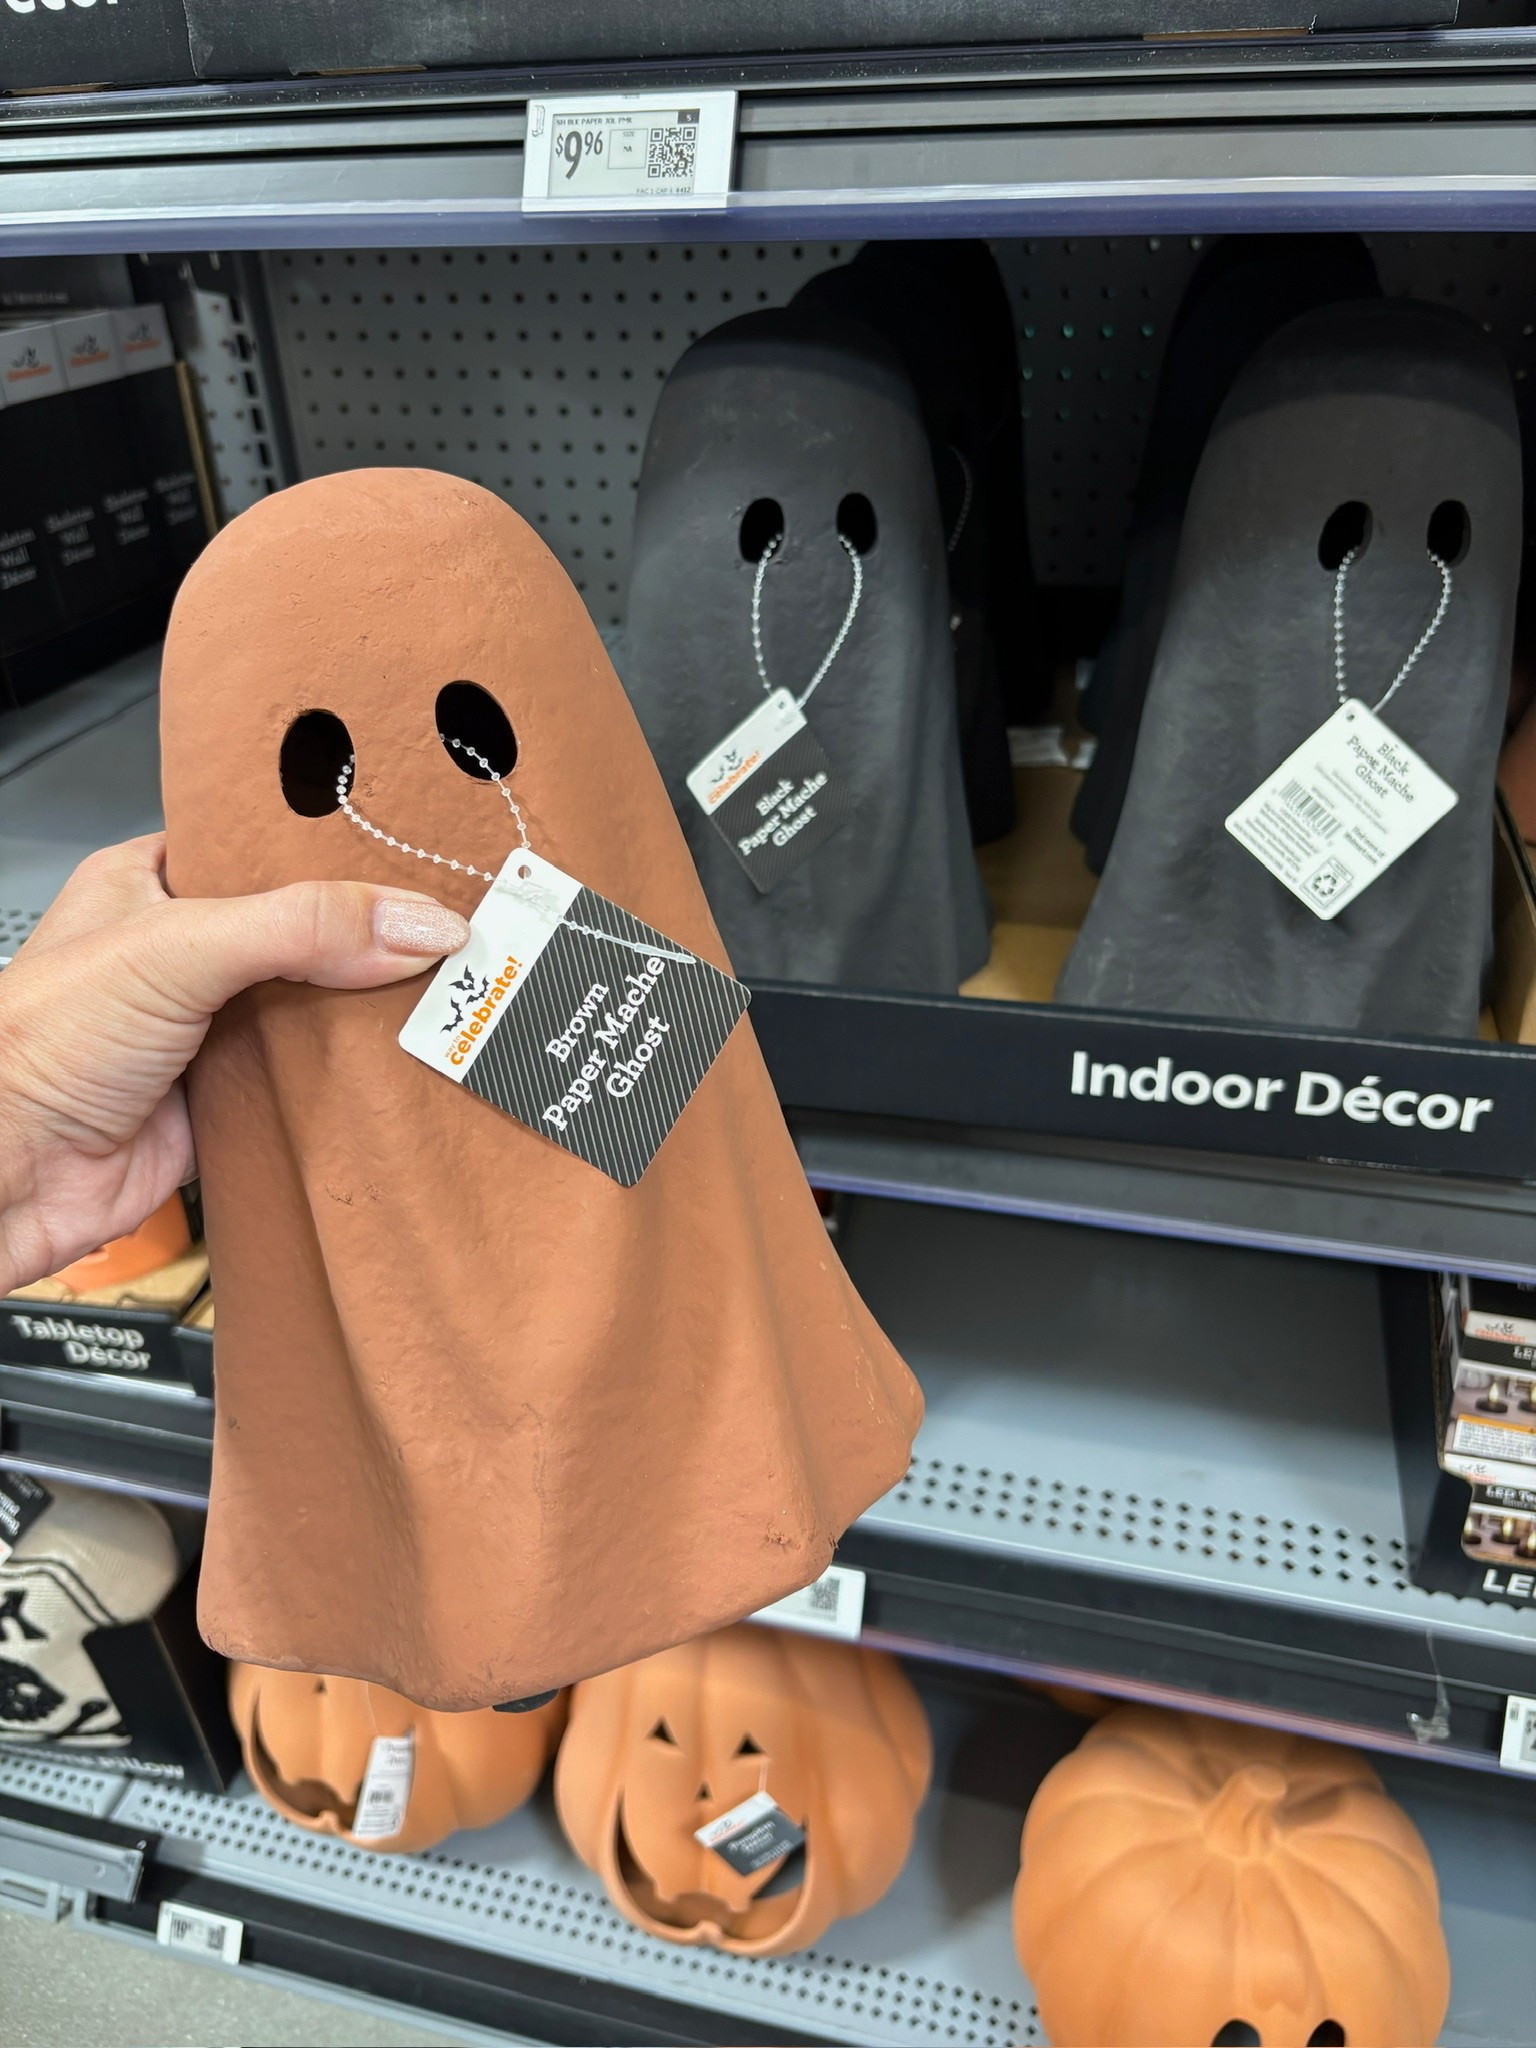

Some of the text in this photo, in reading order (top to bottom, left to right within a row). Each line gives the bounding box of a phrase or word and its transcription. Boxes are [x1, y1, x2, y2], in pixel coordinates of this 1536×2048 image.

[581, 117, 603, 125] PAPER
[1347, 735, 1379, 770] Paper
[1377, 764, 1414, 803] Mache
[1355, 764, 1389, 799] Ghost
[1377, 742, 1409, 778] Black
[737, 771, 828, 857] Paper Mache
[755, 777, 795, 817] Black
[771, 804, 818, 847] Ghost
[450, 955, 523, 1066] celebrate!
[545, 982, 610, 1063] Brown
[541, 956, 666, 1132] Paper Mache
[606, 1015, 671, 1098] Ghost
[1070, 1050, 1494, 1133] Indoor Décor
[10, 1314, 146, 1351] Tabletop
[62, 1339, 152, 1371] Décor
[1482, 1568, 1536, 1599] LE
